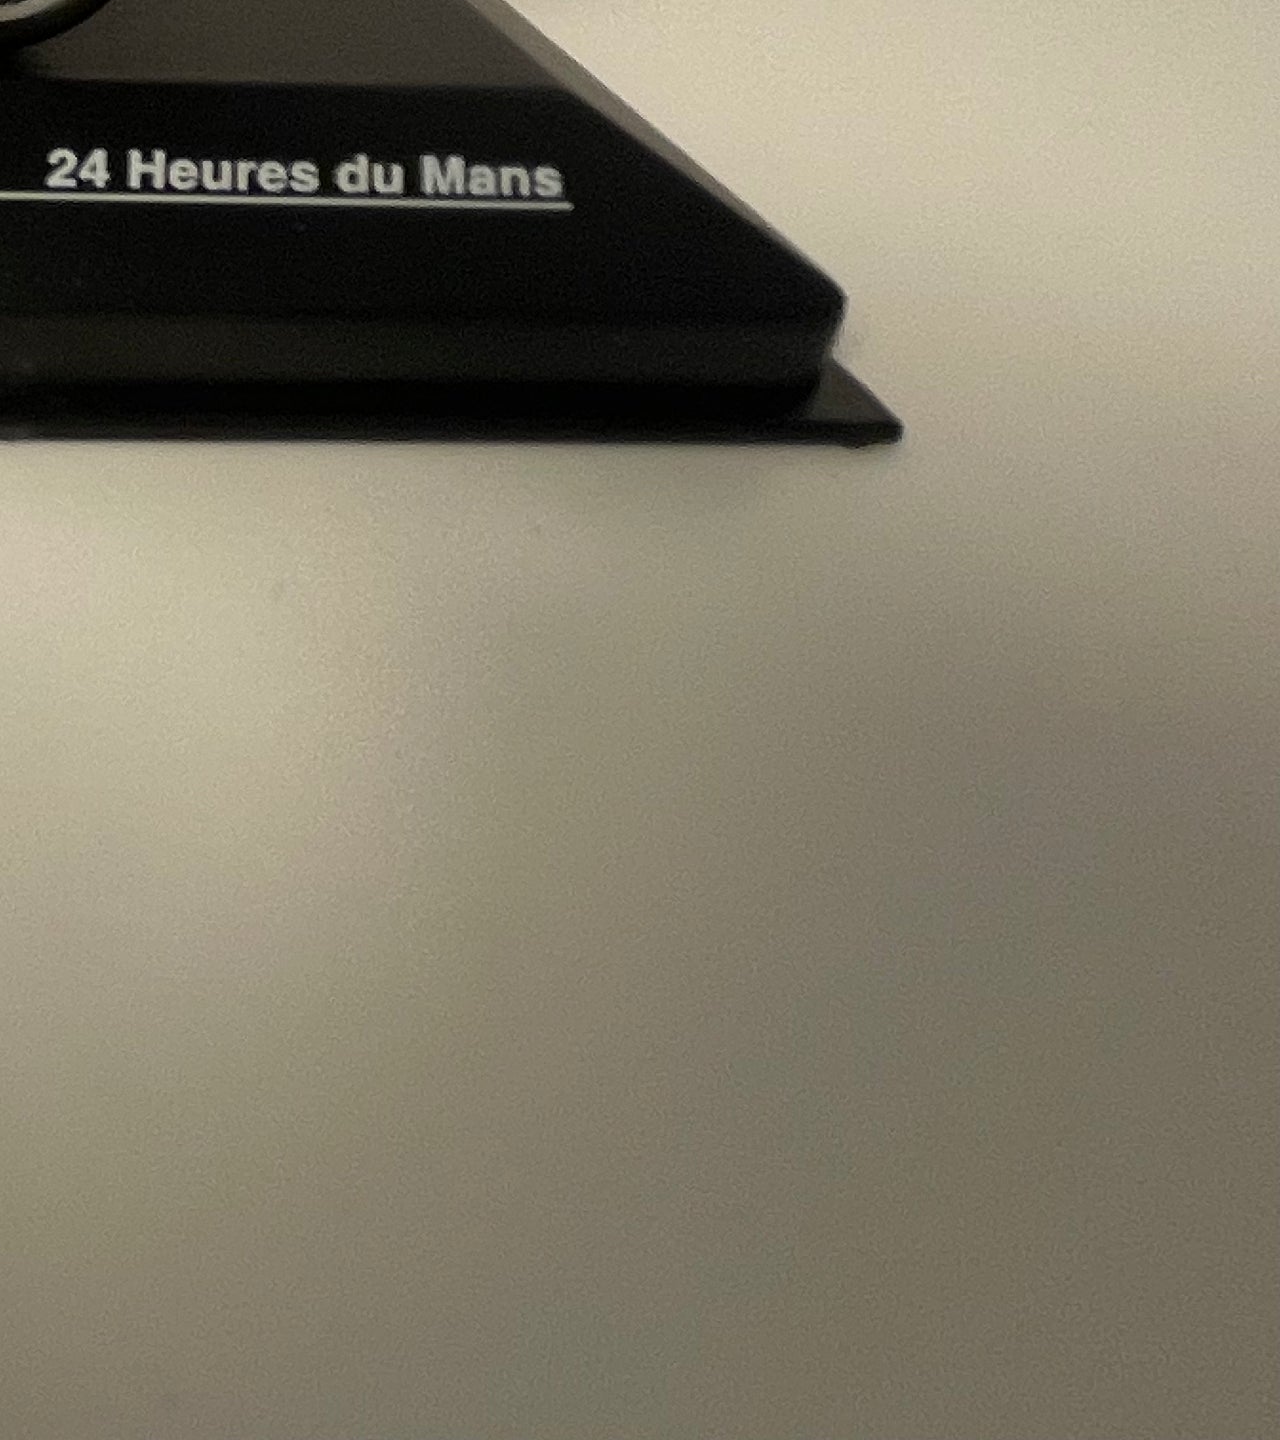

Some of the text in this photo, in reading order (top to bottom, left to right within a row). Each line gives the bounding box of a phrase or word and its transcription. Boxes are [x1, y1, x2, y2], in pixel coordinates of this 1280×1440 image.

[44, 147, 565, 198] 24 Heures du Mans
